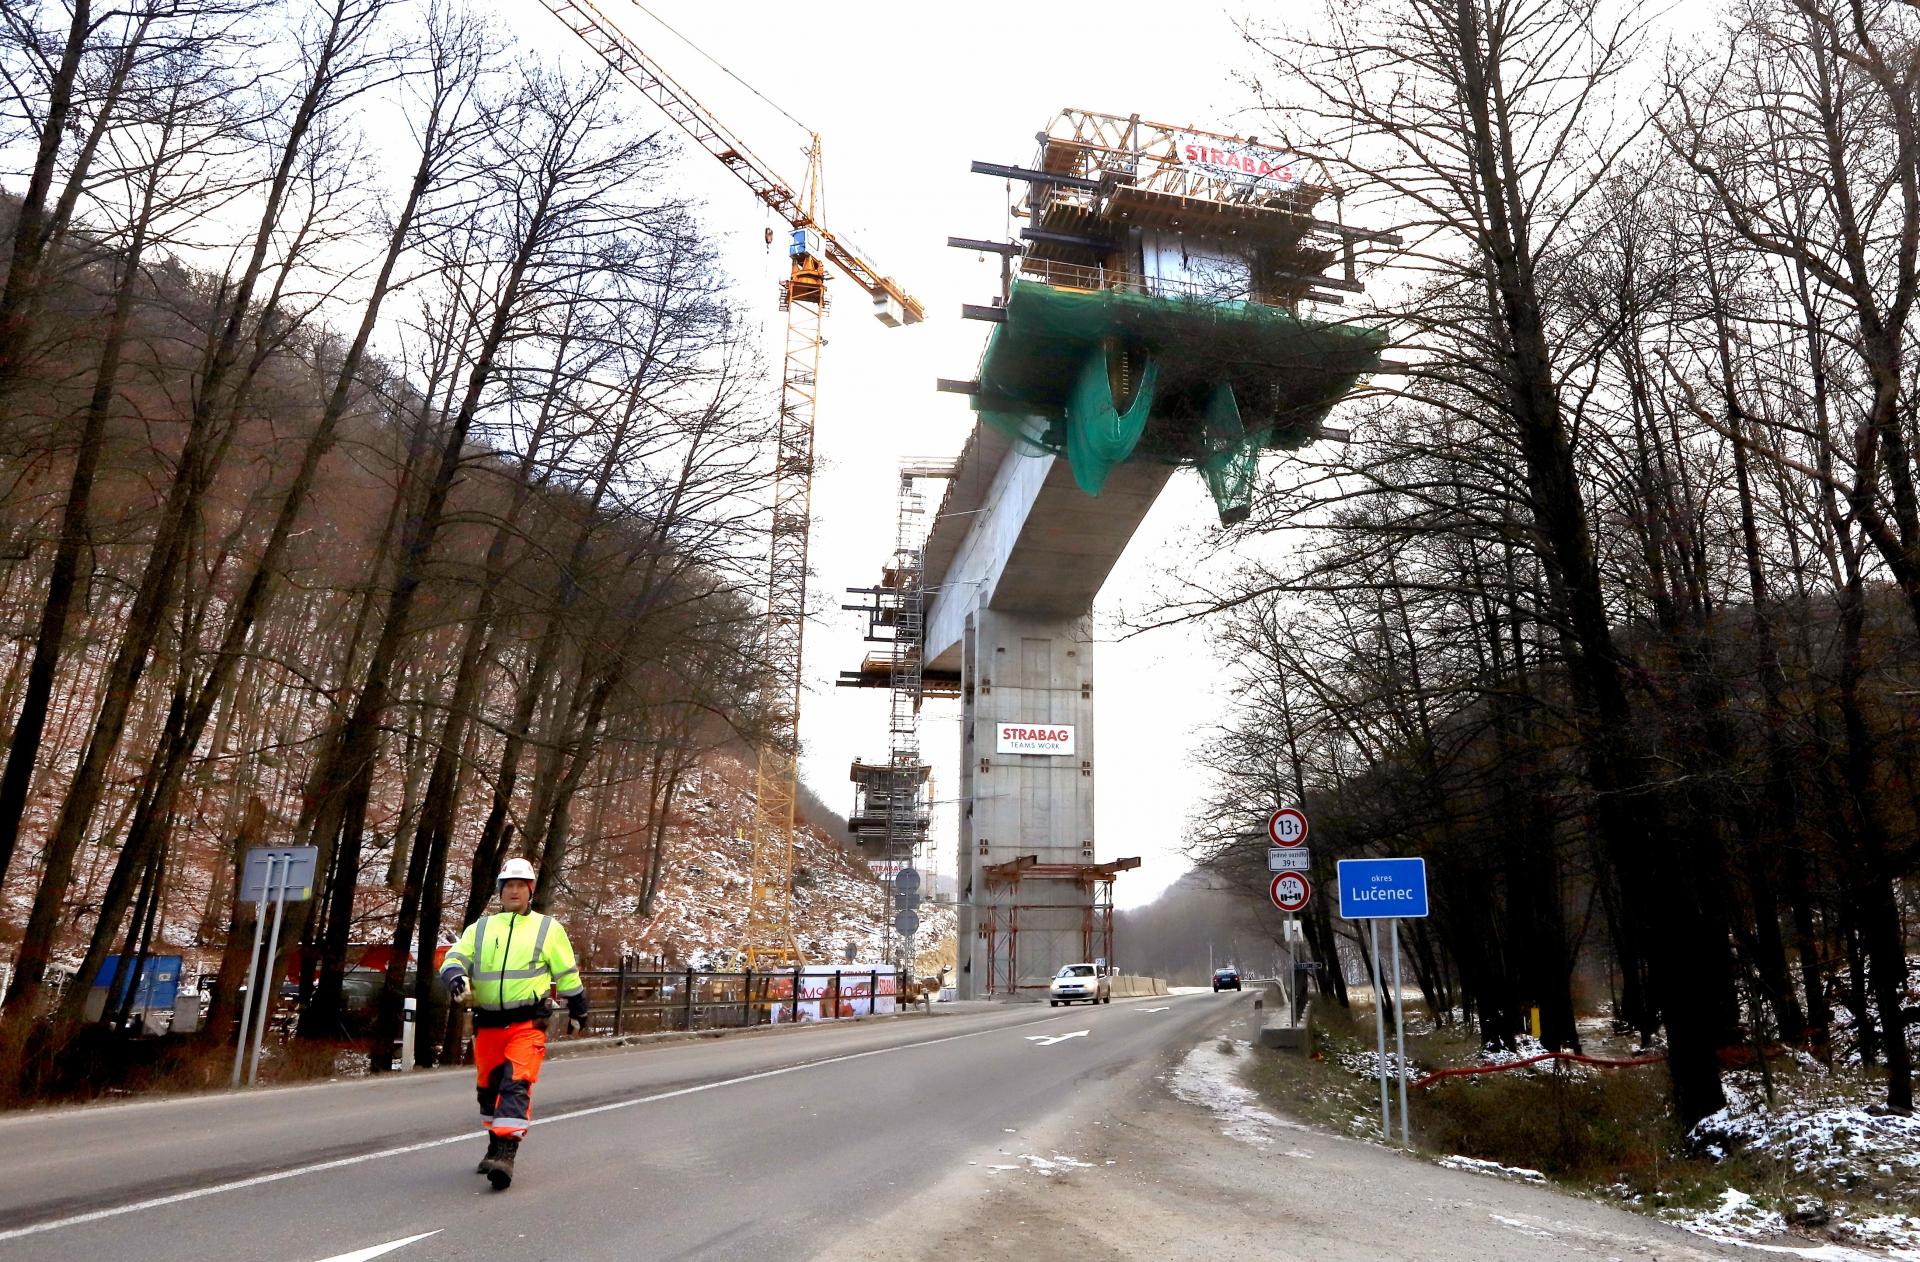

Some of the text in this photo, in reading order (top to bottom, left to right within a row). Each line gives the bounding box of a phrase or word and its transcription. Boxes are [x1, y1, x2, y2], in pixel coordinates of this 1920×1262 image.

[1185, 144, 1292, 182] STRABAG
[1003, 728, 1069, 741] STRABAG
[1010, 741, 1036, 749] TEAMS
[1352, 886, 1414, 901] Lučenec
